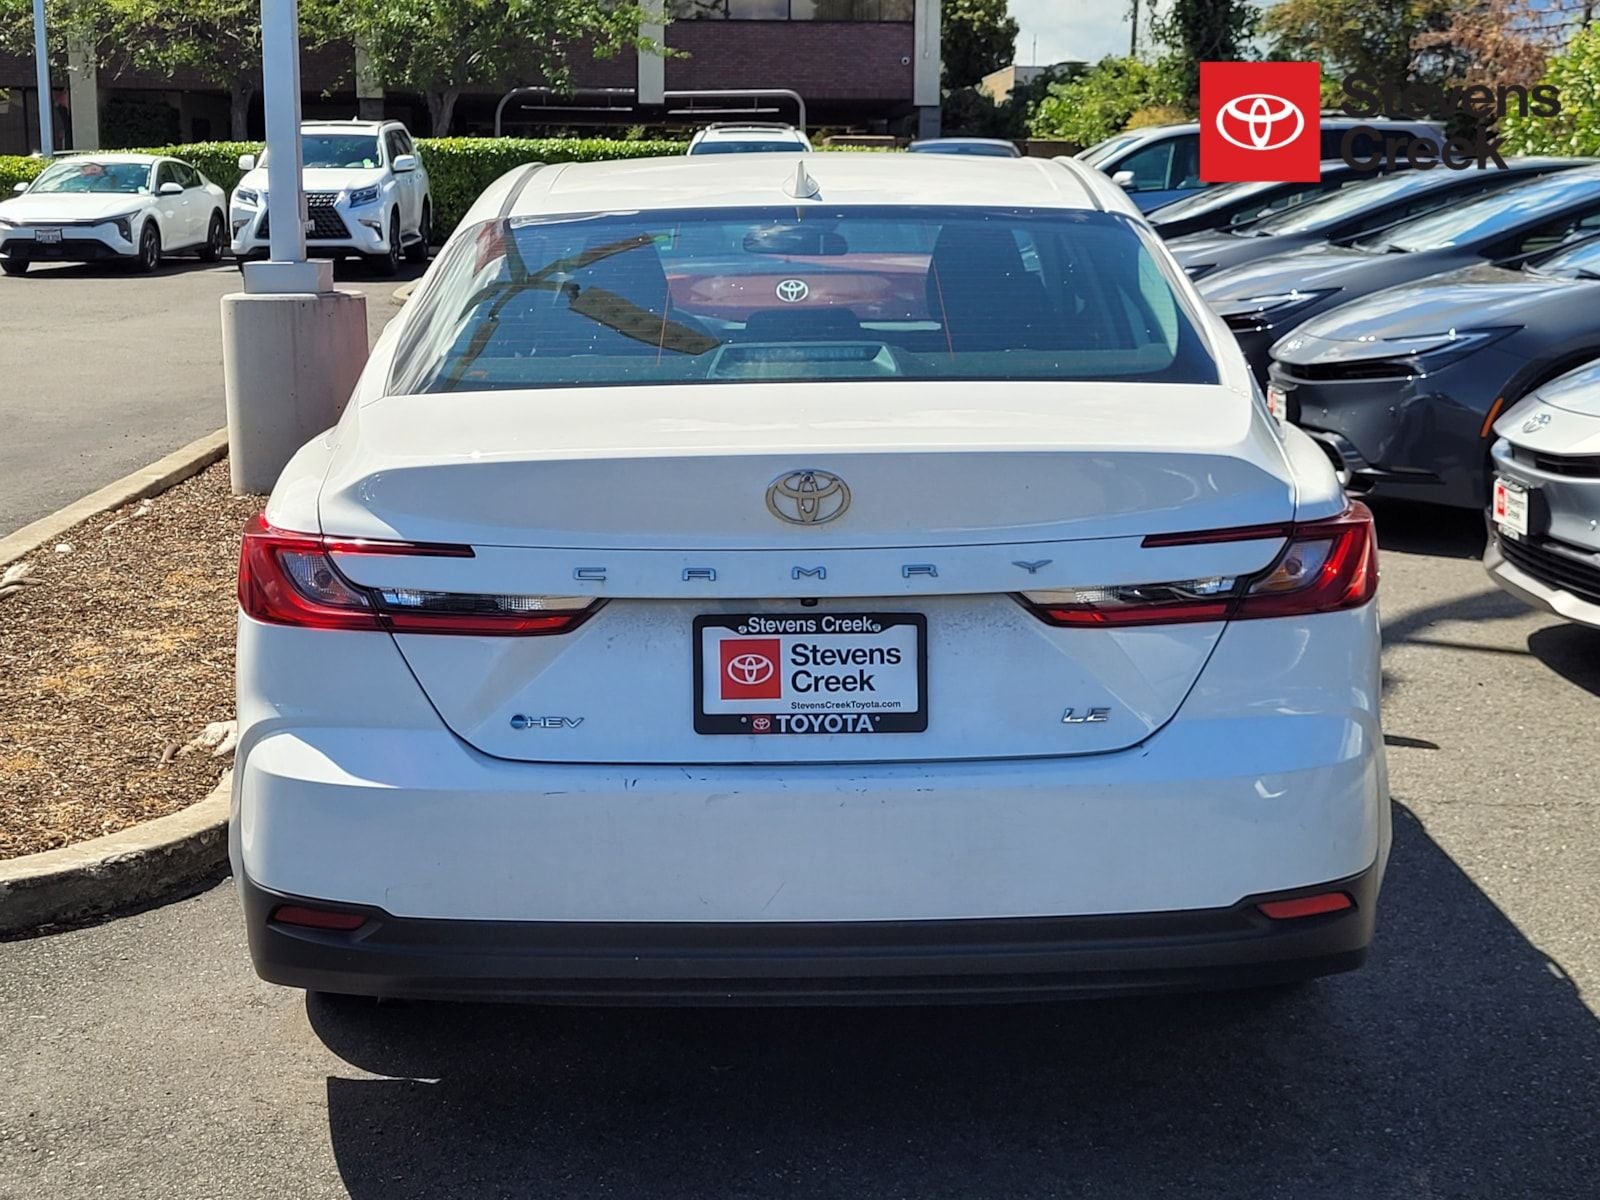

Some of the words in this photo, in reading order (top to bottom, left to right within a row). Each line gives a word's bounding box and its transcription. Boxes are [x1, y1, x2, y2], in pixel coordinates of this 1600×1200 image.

[572, 558, 1053, 582] CAMRY
[748, 617, 816, 633] Stevens
[821, 616, 873, 632] Creek
[790, 643, 901, 666] Stevens
[791, 669, 875, 693] Creek
[790, 700, 901, 709] StevensCreekToyota.com
[776, 714, 874, 733] TOYOTA
[1062, 708, 1112, 723] LE
